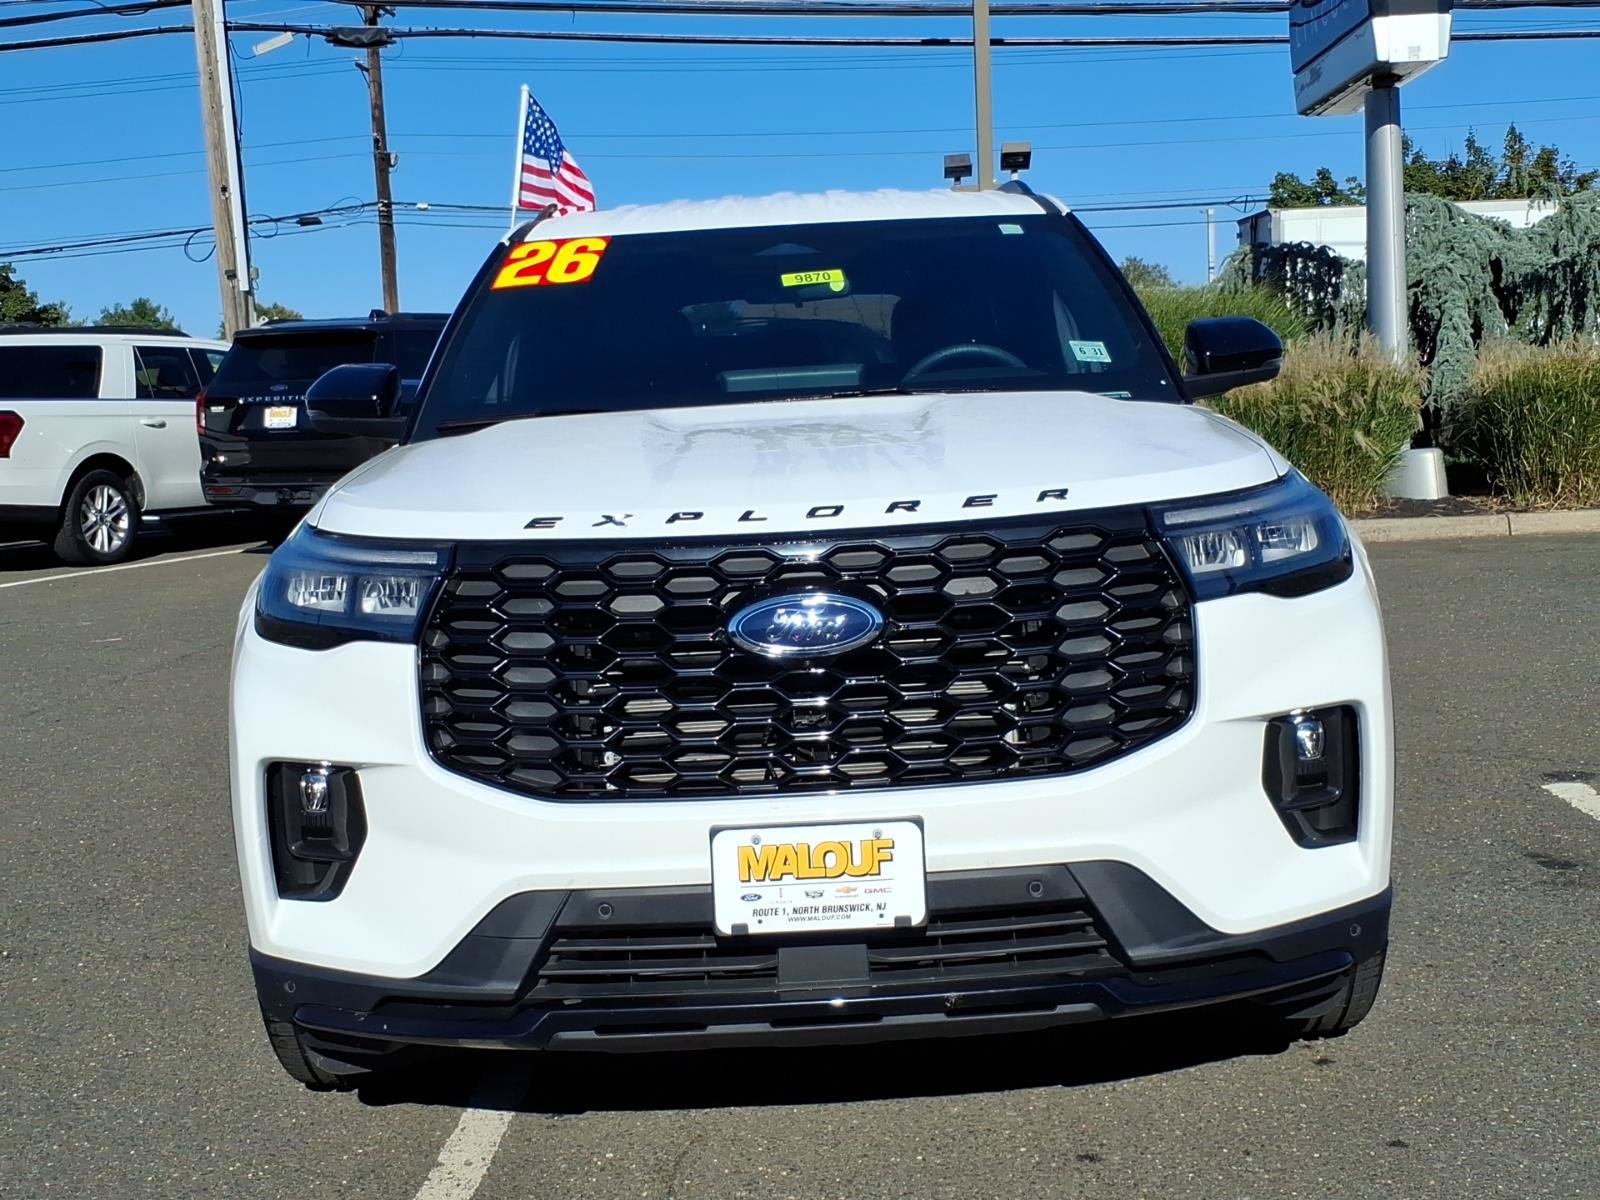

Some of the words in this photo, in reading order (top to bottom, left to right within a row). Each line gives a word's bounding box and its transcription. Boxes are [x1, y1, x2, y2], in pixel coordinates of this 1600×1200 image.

[491, 237, 607, 289] 26
[794, 271, 831, 284] 9870
[1079, 347, 1086, 355] 6
[523, 487, 1070, 531] EXPLORER
[738, 839, 894, 882] MALOUF
[752, 907, 780, 917] ROUTE
[782, 907, 790, 916] 1,
[792, 905, 820, 915] NORTH
[821, 903, 874, 914] BRUNSWICK,
[876, 902, 887, 911] NJ
[788, 914, 852, 922] WWW.MALOUF.COM
